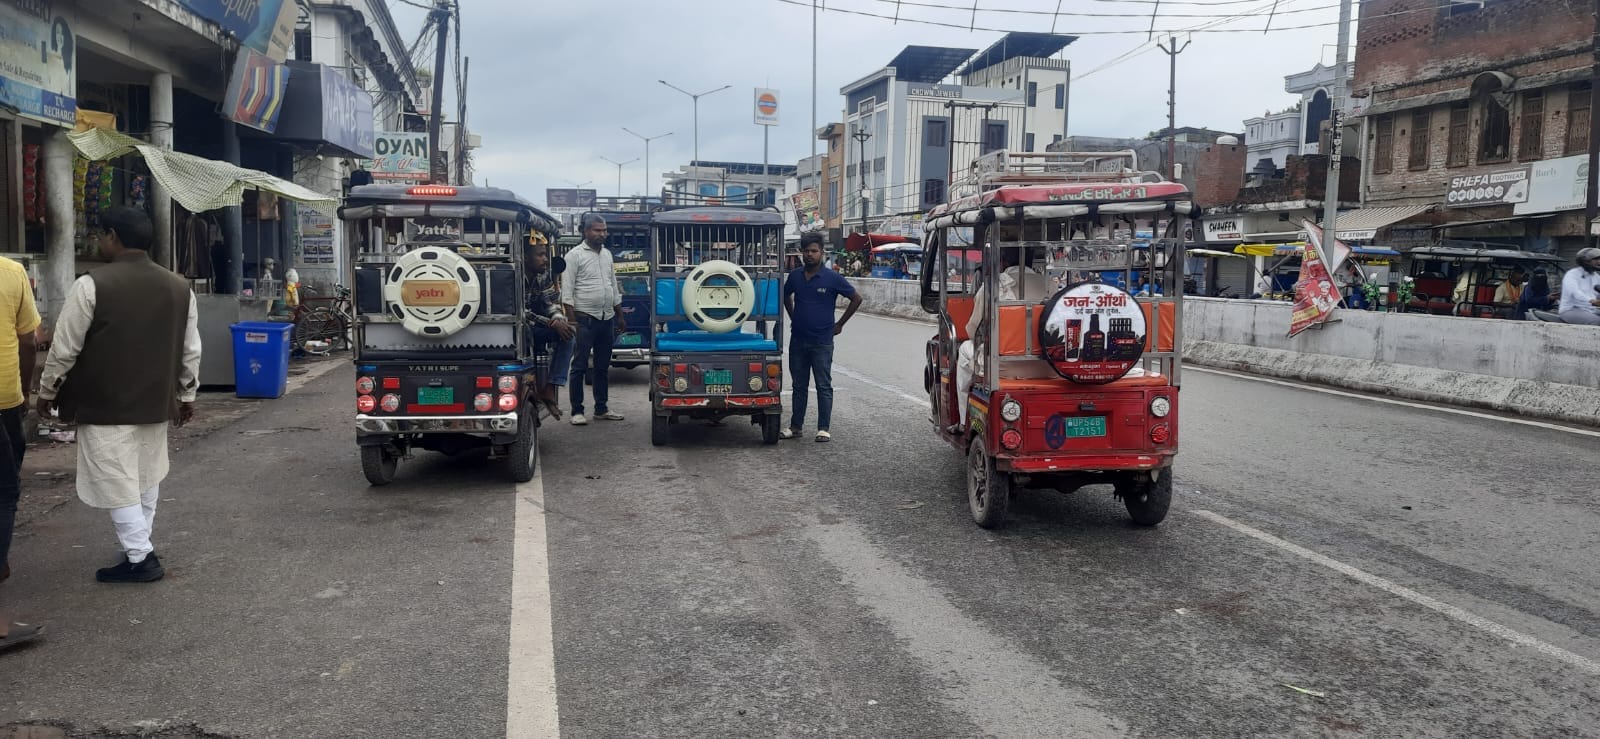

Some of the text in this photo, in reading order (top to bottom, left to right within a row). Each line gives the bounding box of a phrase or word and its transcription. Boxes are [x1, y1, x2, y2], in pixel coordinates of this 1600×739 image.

[911, 88, 960, 98] CROWN JEWELS
[43, 104, 75, 121] RECHARGE
[1451, 172, 1525, 189] SHEFA FOOTWEAR
[1208, 221, 1237, 233] SHAHEEN
[415, 287, 444, 300] yatri
